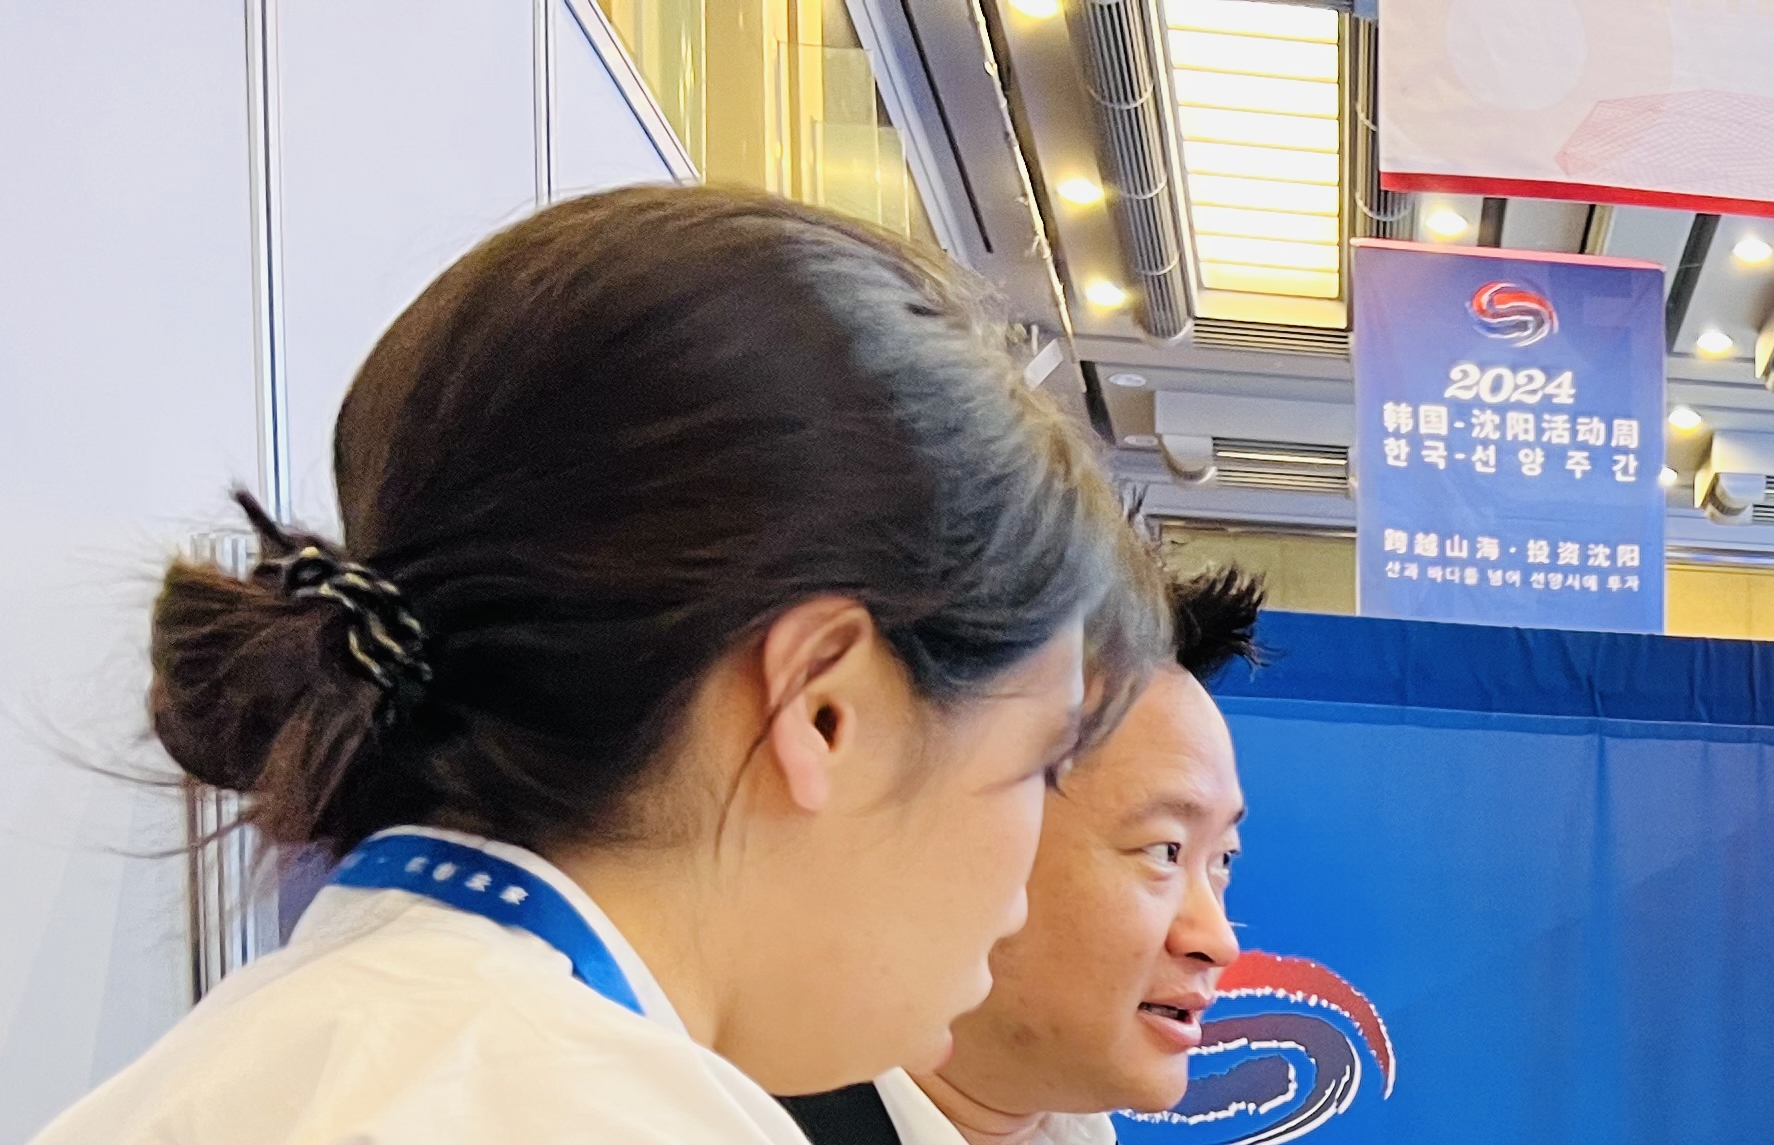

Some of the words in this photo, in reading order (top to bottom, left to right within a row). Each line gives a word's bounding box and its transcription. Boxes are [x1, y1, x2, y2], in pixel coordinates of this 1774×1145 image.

[1443, 363, 1576, 404] 2024
[1382, 402, 1640, 450] 韩国-沈阳活动周
